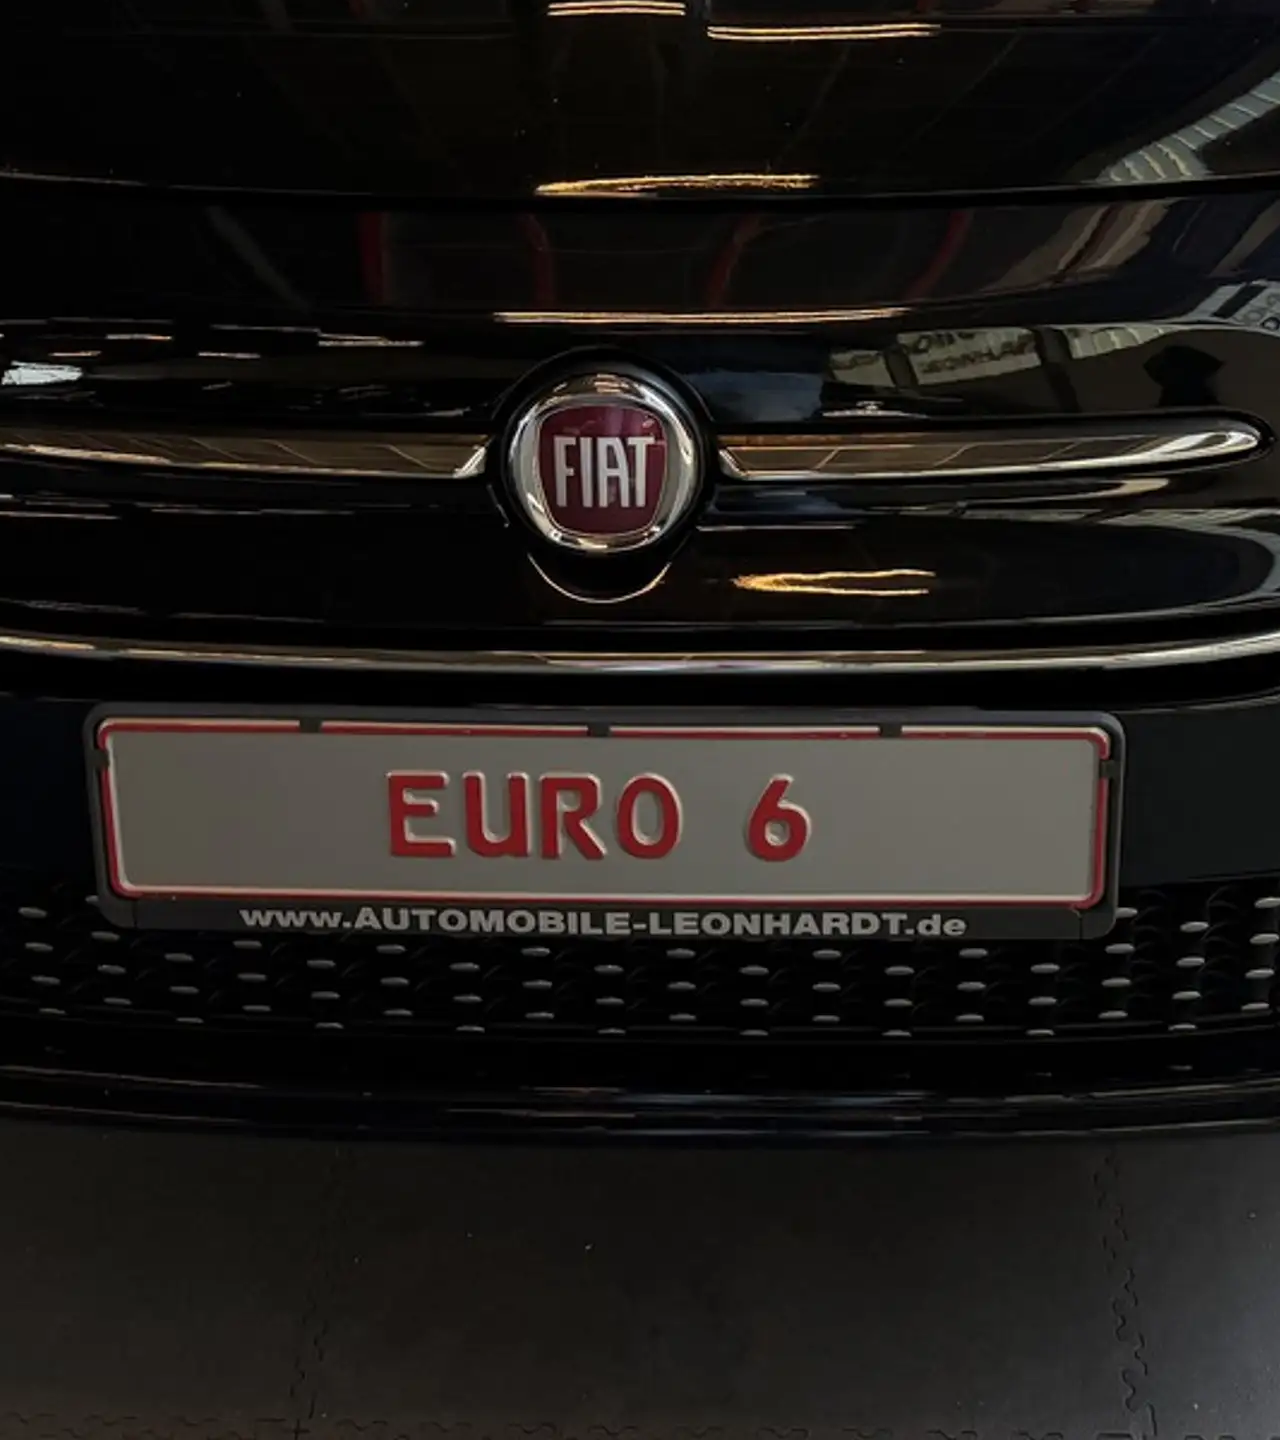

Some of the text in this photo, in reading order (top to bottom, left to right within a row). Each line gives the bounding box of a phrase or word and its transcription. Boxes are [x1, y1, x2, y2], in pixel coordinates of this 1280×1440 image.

[553, 436, 655, 507] FIAT
[385, 770, 811, 863] EURO 6
[239, 904, 967, 939] www.AUTOMOBILE-LEONHARDT.de
